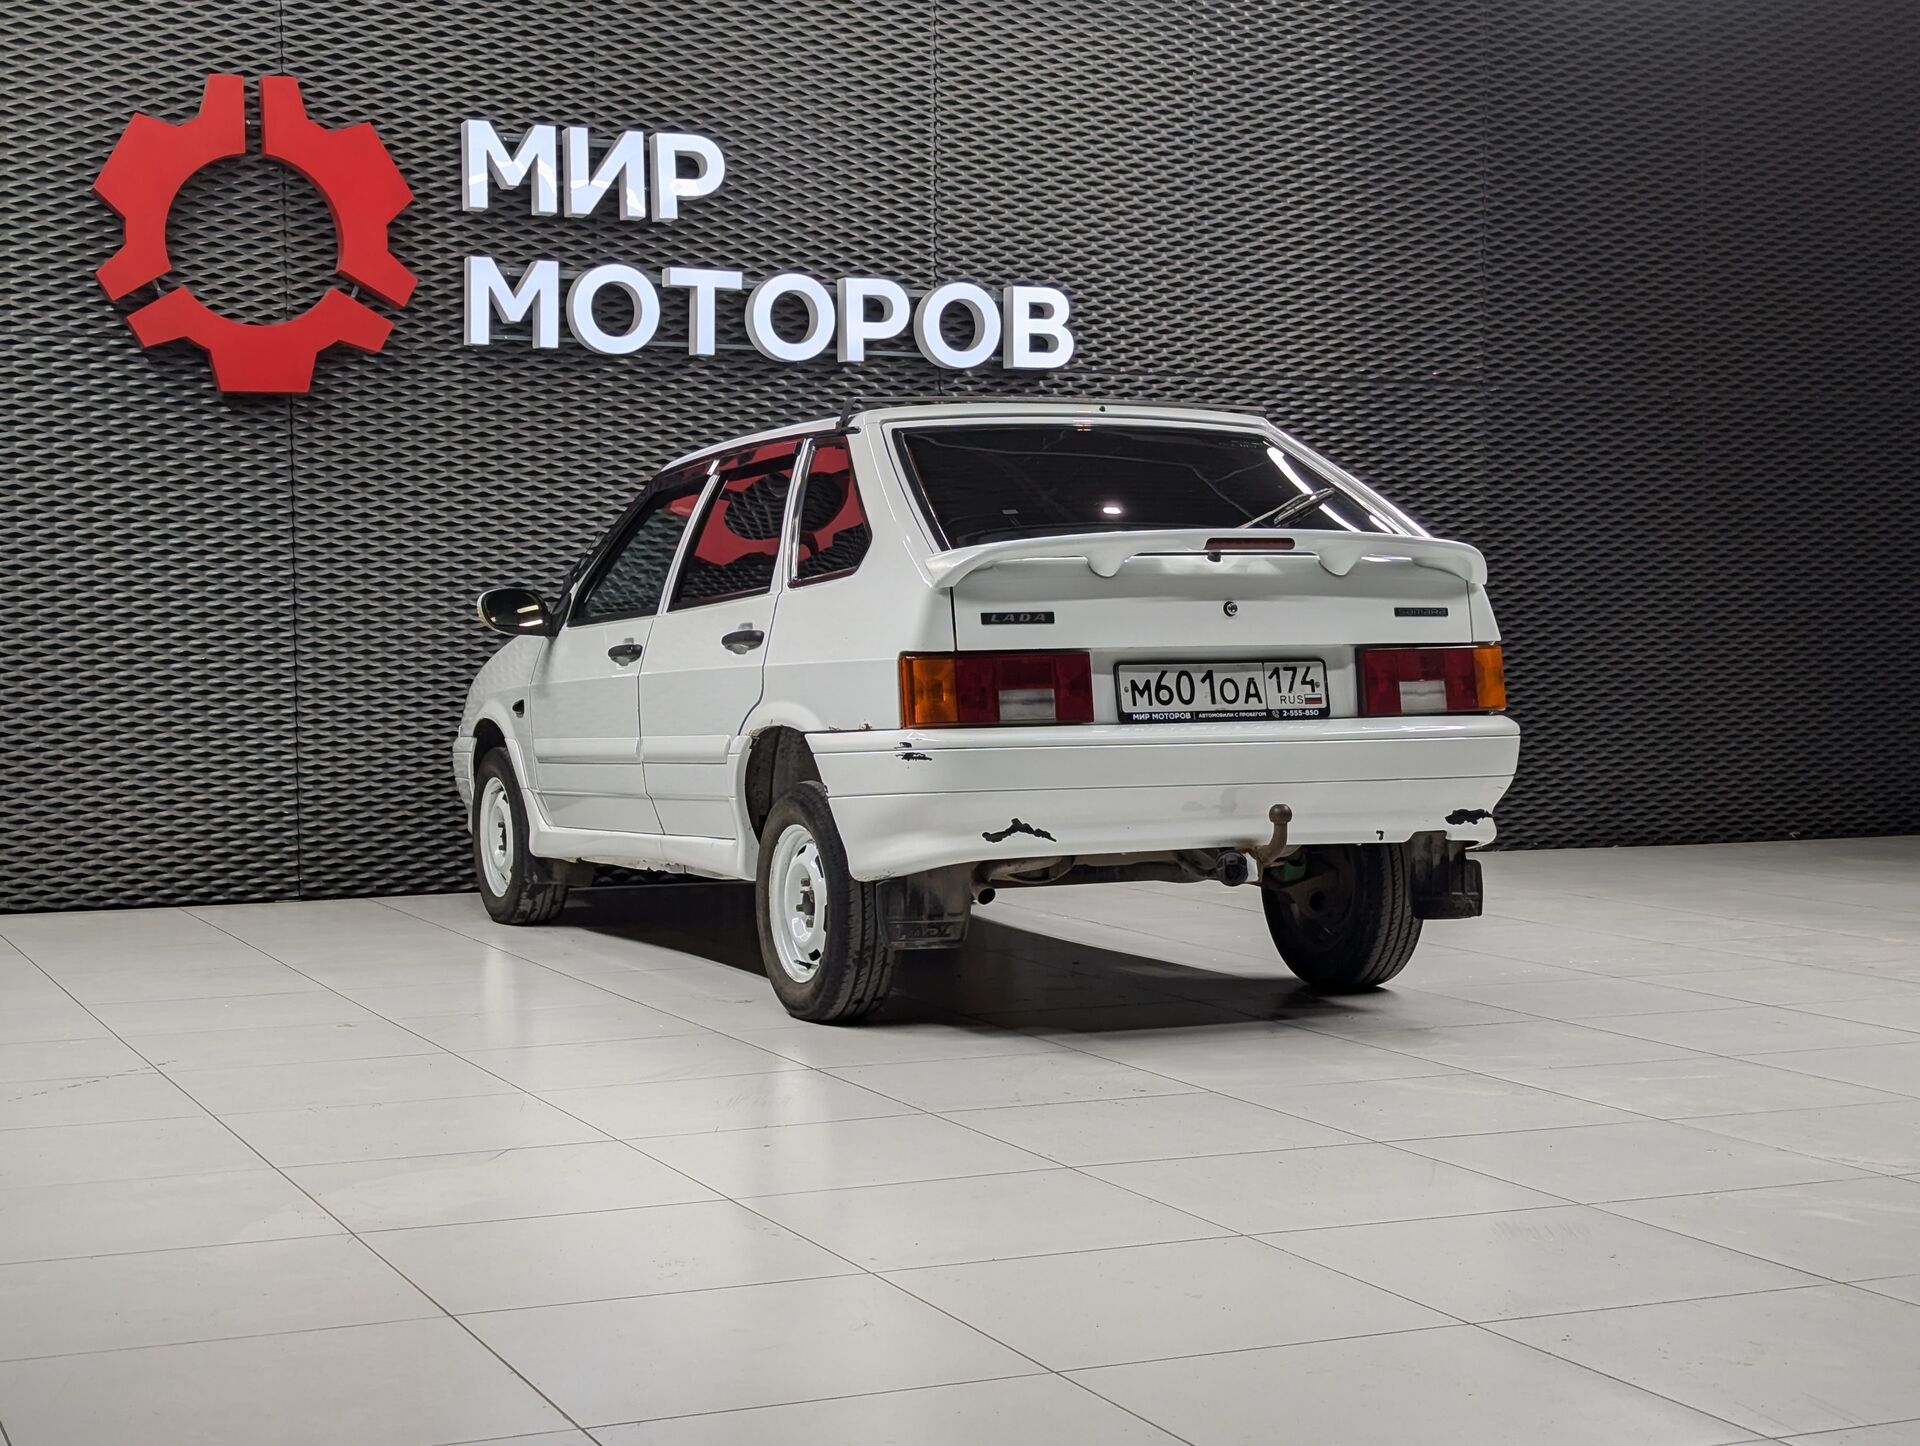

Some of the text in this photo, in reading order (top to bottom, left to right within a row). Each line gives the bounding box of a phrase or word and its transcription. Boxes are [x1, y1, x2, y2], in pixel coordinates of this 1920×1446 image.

[461, 119, 726, 223] МИР
[464, 256, 1074, 370] МОТОРОВ
[990, 613, 1046, 622] LADA
[1268, 666, 1316, 694] 174
[1280, 695, 1304, 705] RUS
[1151, 712, 1191, 720] МОТОРОВ
[1282, 709, 1319, 717] 2-555-850
